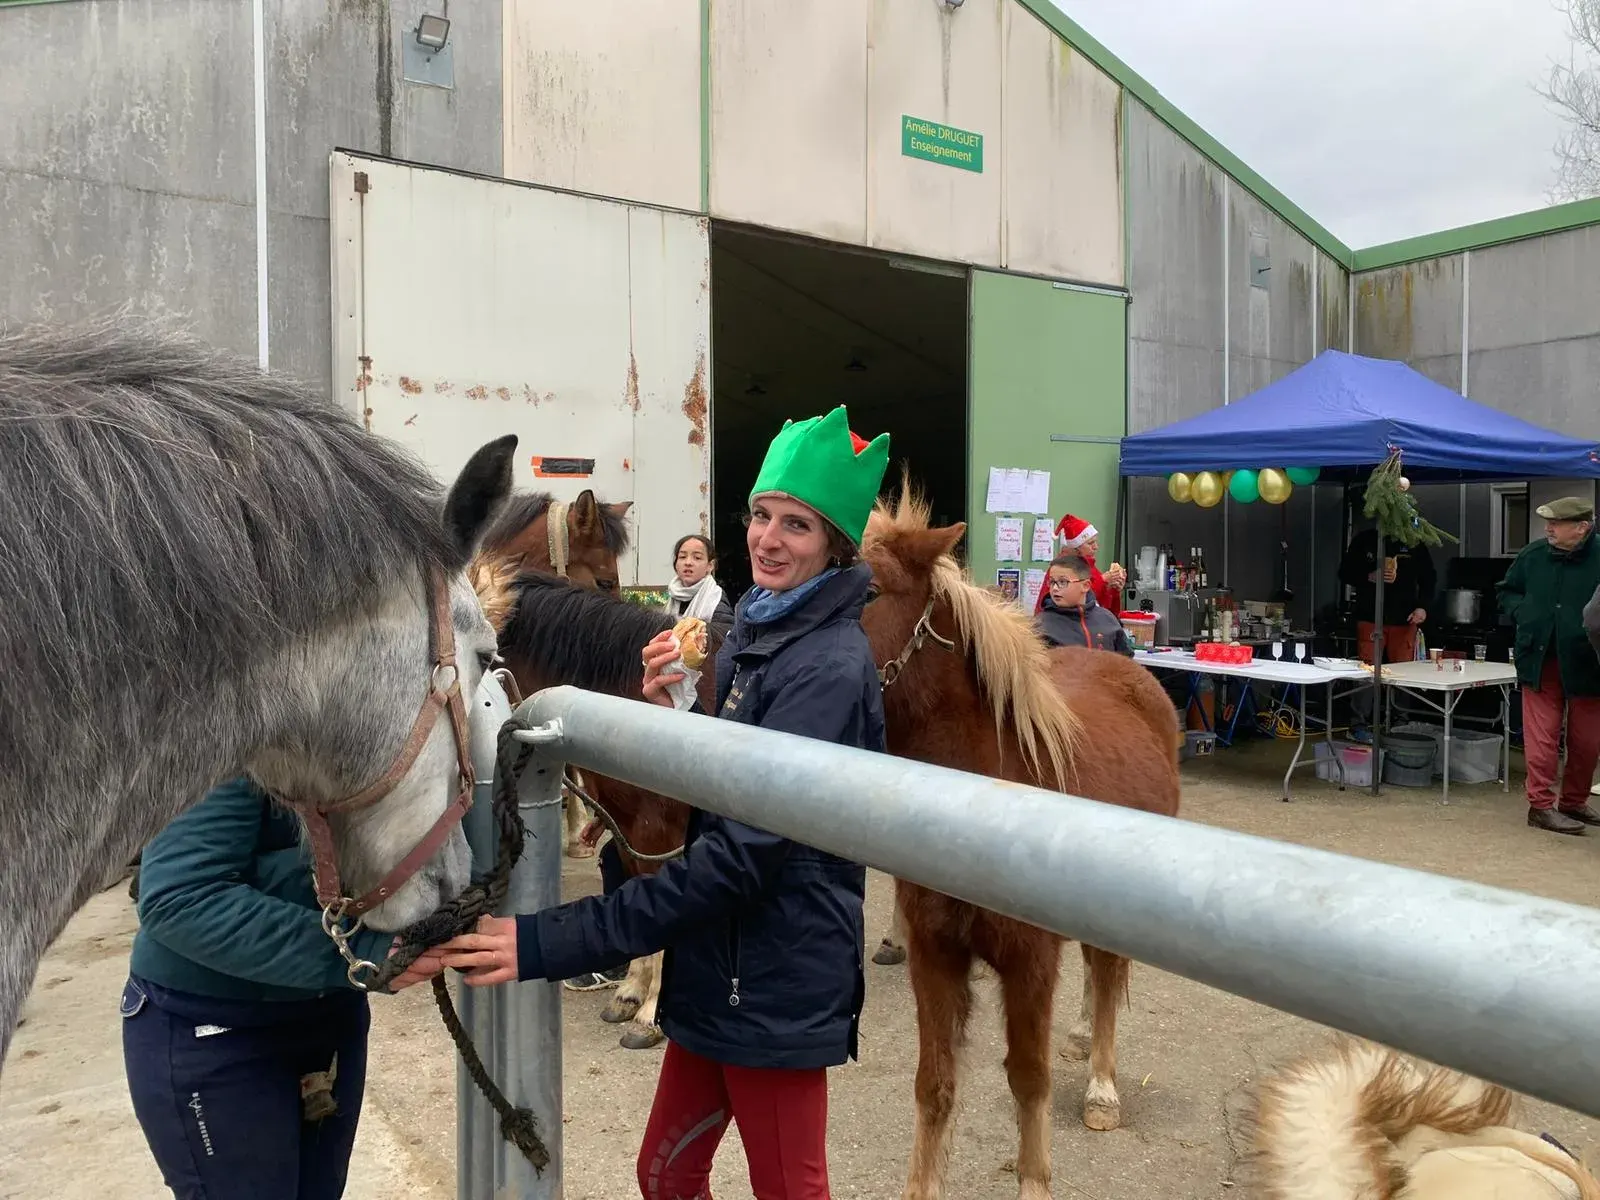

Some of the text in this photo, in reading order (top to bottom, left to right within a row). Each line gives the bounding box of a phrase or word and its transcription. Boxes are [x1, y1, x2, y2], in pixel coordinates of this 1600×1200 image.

[906, 119, 980, 147] Amélie DRUGUET
[911, 137, 972, 162] Enseignement
